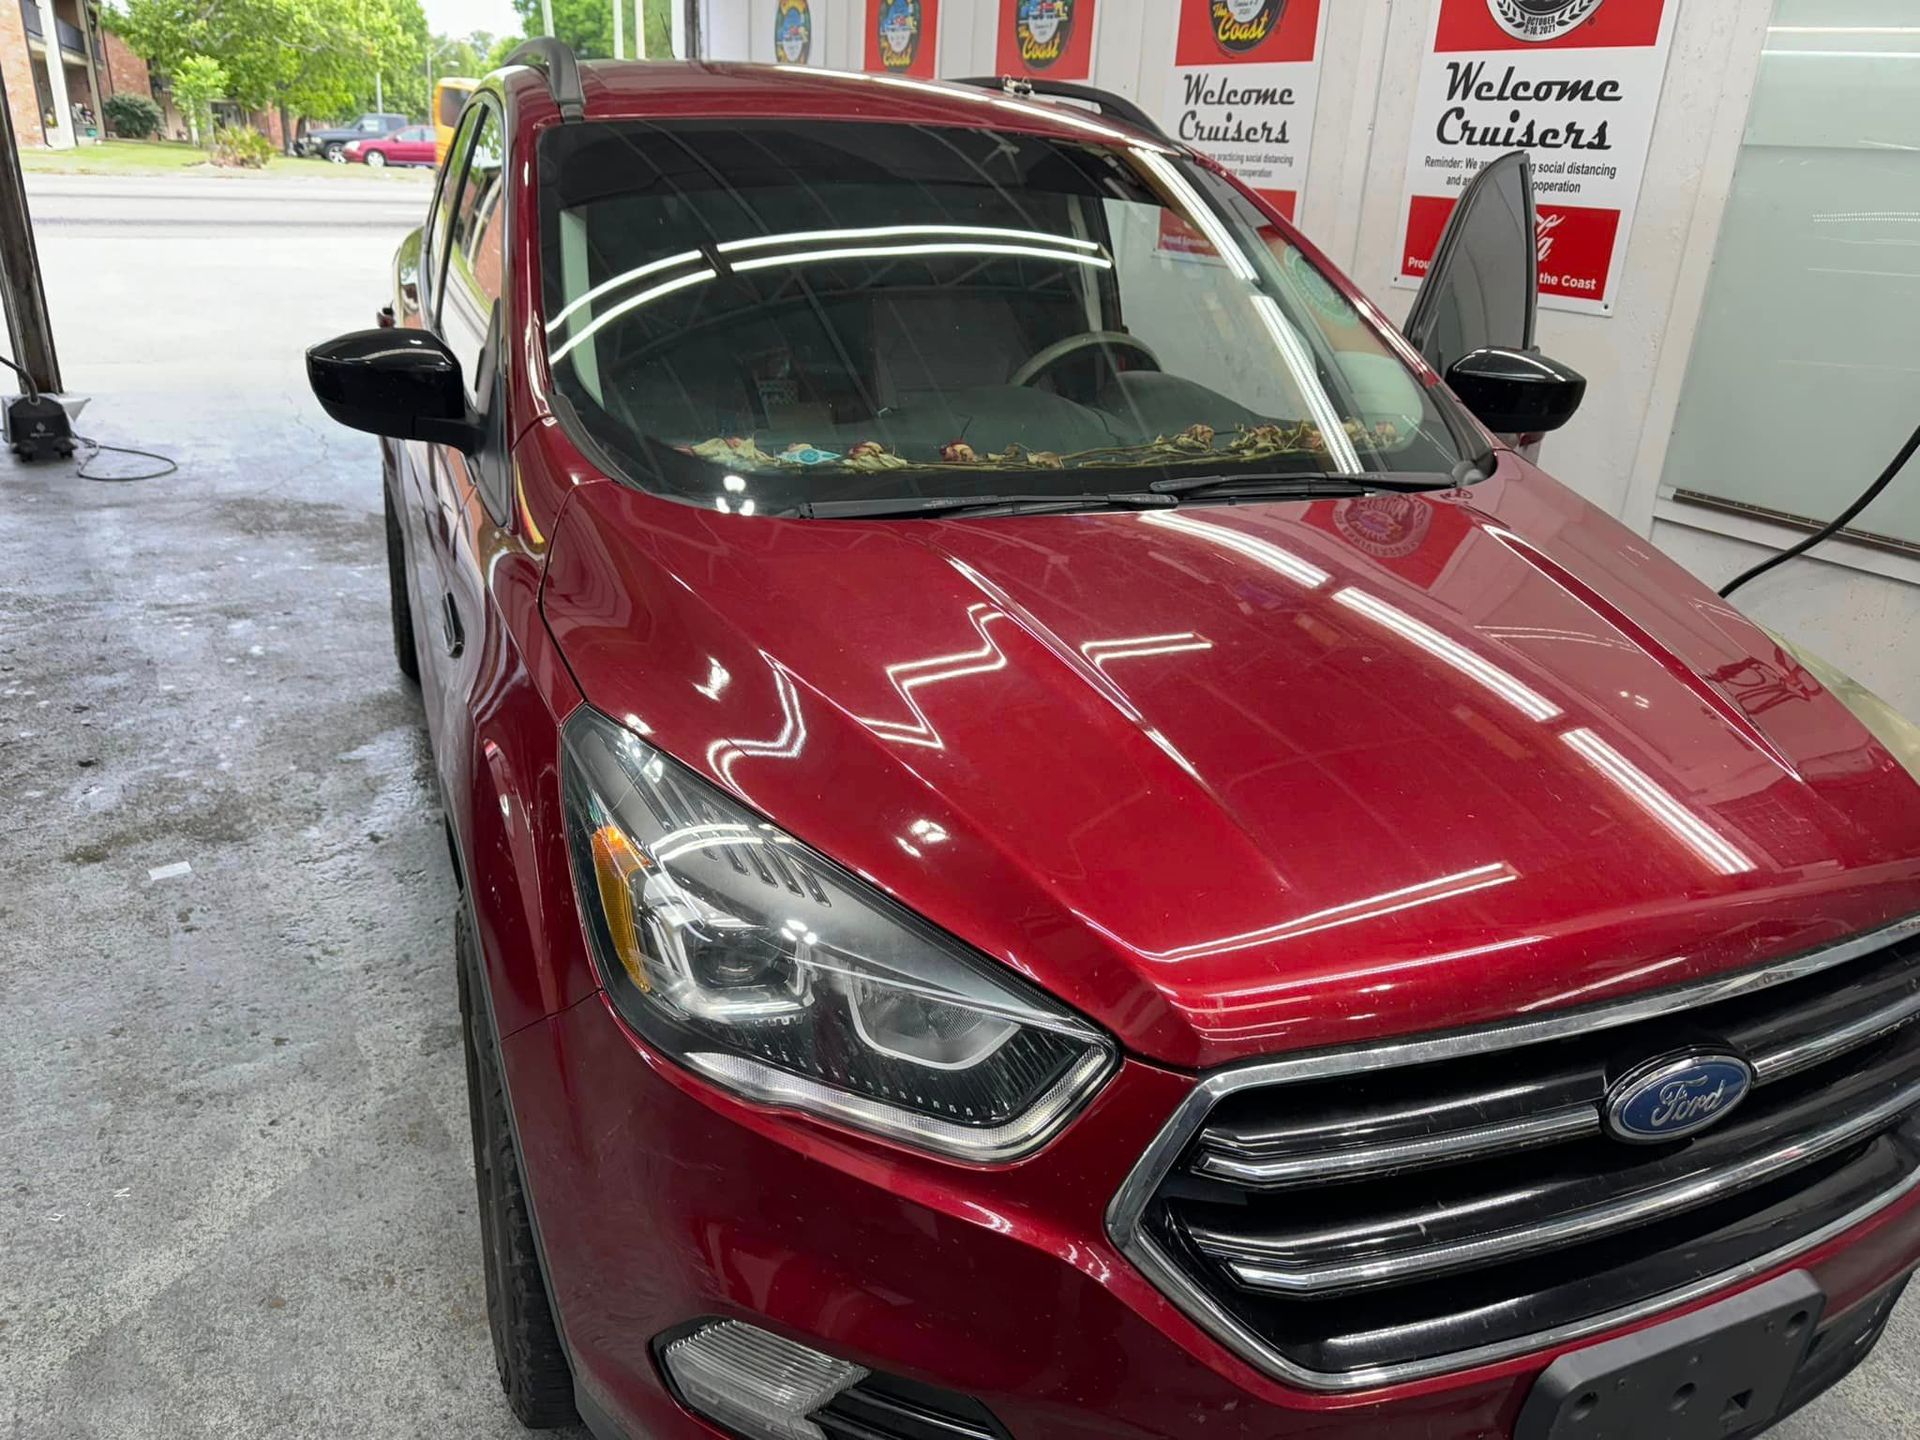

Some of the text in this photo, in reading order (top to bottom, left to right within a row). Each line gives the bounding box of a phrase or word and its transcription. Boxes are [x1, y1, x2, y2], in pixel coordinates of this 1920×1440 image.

[1218, 9, 1270, 42] Coast
[1526, 15, 1556, 26] OCTOBER
[1539, 24, 1556, 34] 2021
[1022, 32, 1060, 60] Coast
[1183, 73, 1296, 106] Welcome
[1446, 61, 1623, 102] Welcome
[1178, 110, 1290, 144] Cruisers
[1436, 106, 1612, 150] Cruisers
[1246, 152, 1262, 164] social
[1263, 153, 1294, 168] distancing
[1424, 155, 1463, 170] Reminder:
[1465, 157, 1478, 170] We
[1537, 160, 1565, 174] social
[1566, 161, 1617, 180] distancing
[1446, 175, 1461, 187] and
[1539, 272, 1557, 285] the
[1561, 275, 1596, 290] Coast
[1651, 1074, 1726, 1127] Ford
